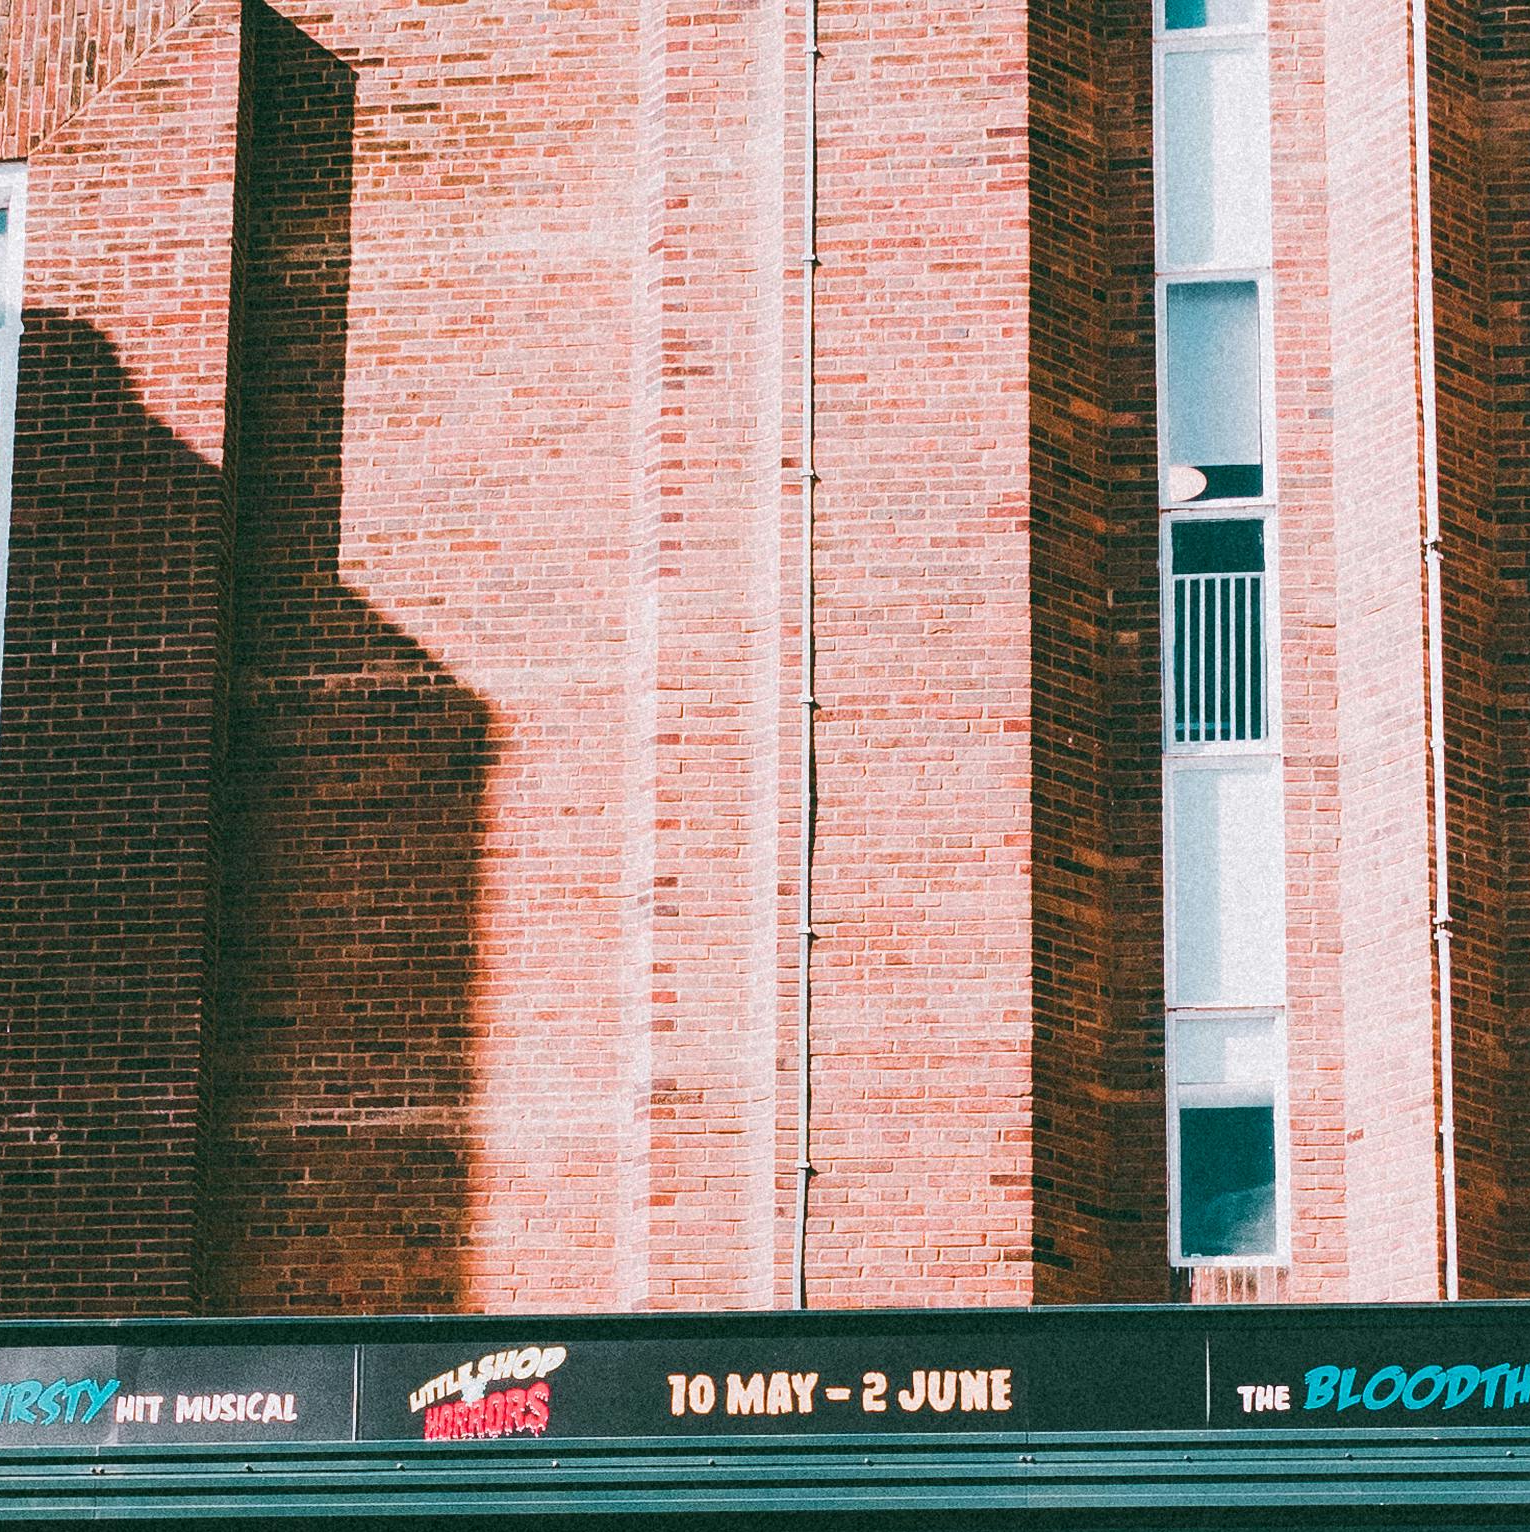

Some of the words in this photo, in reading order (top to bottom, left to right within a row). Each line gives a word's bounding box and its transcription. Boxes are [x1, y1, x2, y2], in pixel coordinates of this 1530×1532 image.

[409, 1361, 474, 1413] LITTLE
[477, 1346, 567, 1381] SHOP
[667, 1373, 714, 1416] 10
[725, 1371, 819, 1416] MAY
[862, 1372, 887, 1412] 2
[897, 1368, 1012, 1413] JUNE
[1237, 1384, 1291, 1413] THE
[115, 1394, 163, 1424] HIT
[175, 1391, 298, 1424] MUSICAL
[424, 1382, 550, 1440] HORRORS
